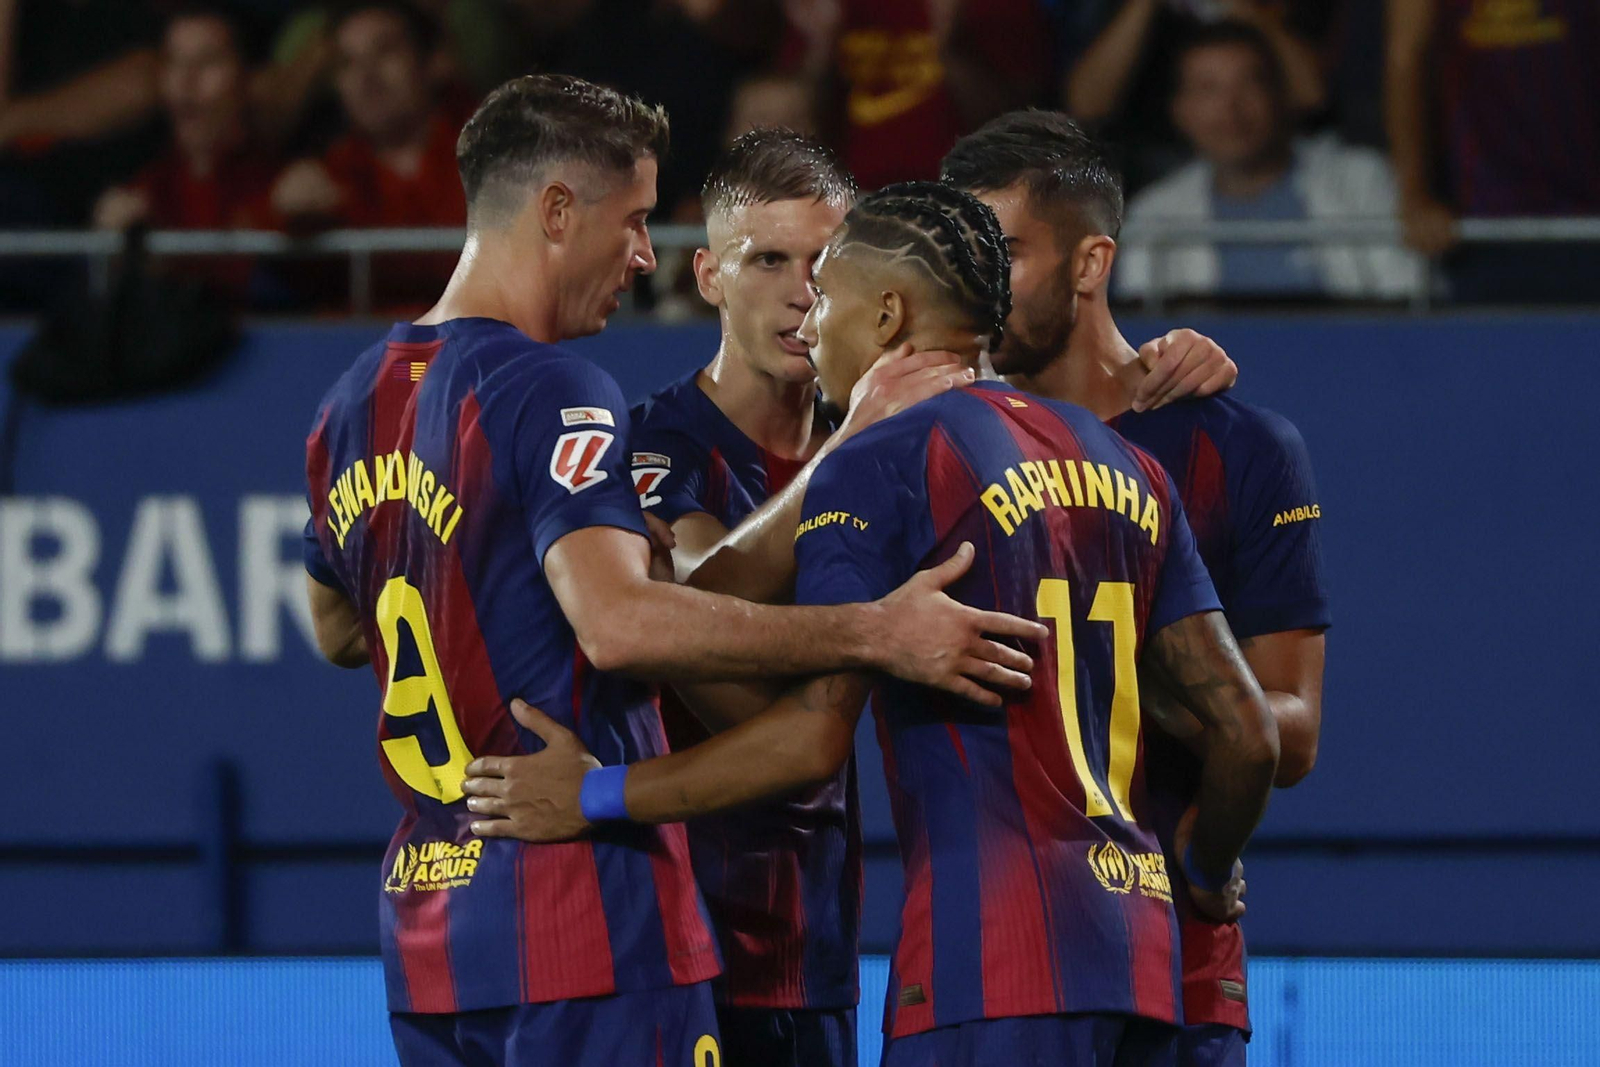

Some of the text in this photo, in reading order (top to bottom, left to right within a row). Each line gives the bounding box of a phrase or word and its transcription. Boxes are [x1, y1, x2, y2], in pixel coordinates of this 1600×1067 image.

[327, 449, 463, 550] LEWANDWSKI
[980, 459, 1159, 546] RAPHINHA
[376, 575, 476, 804] 9
[1036, 578, 1140, 822] 11
